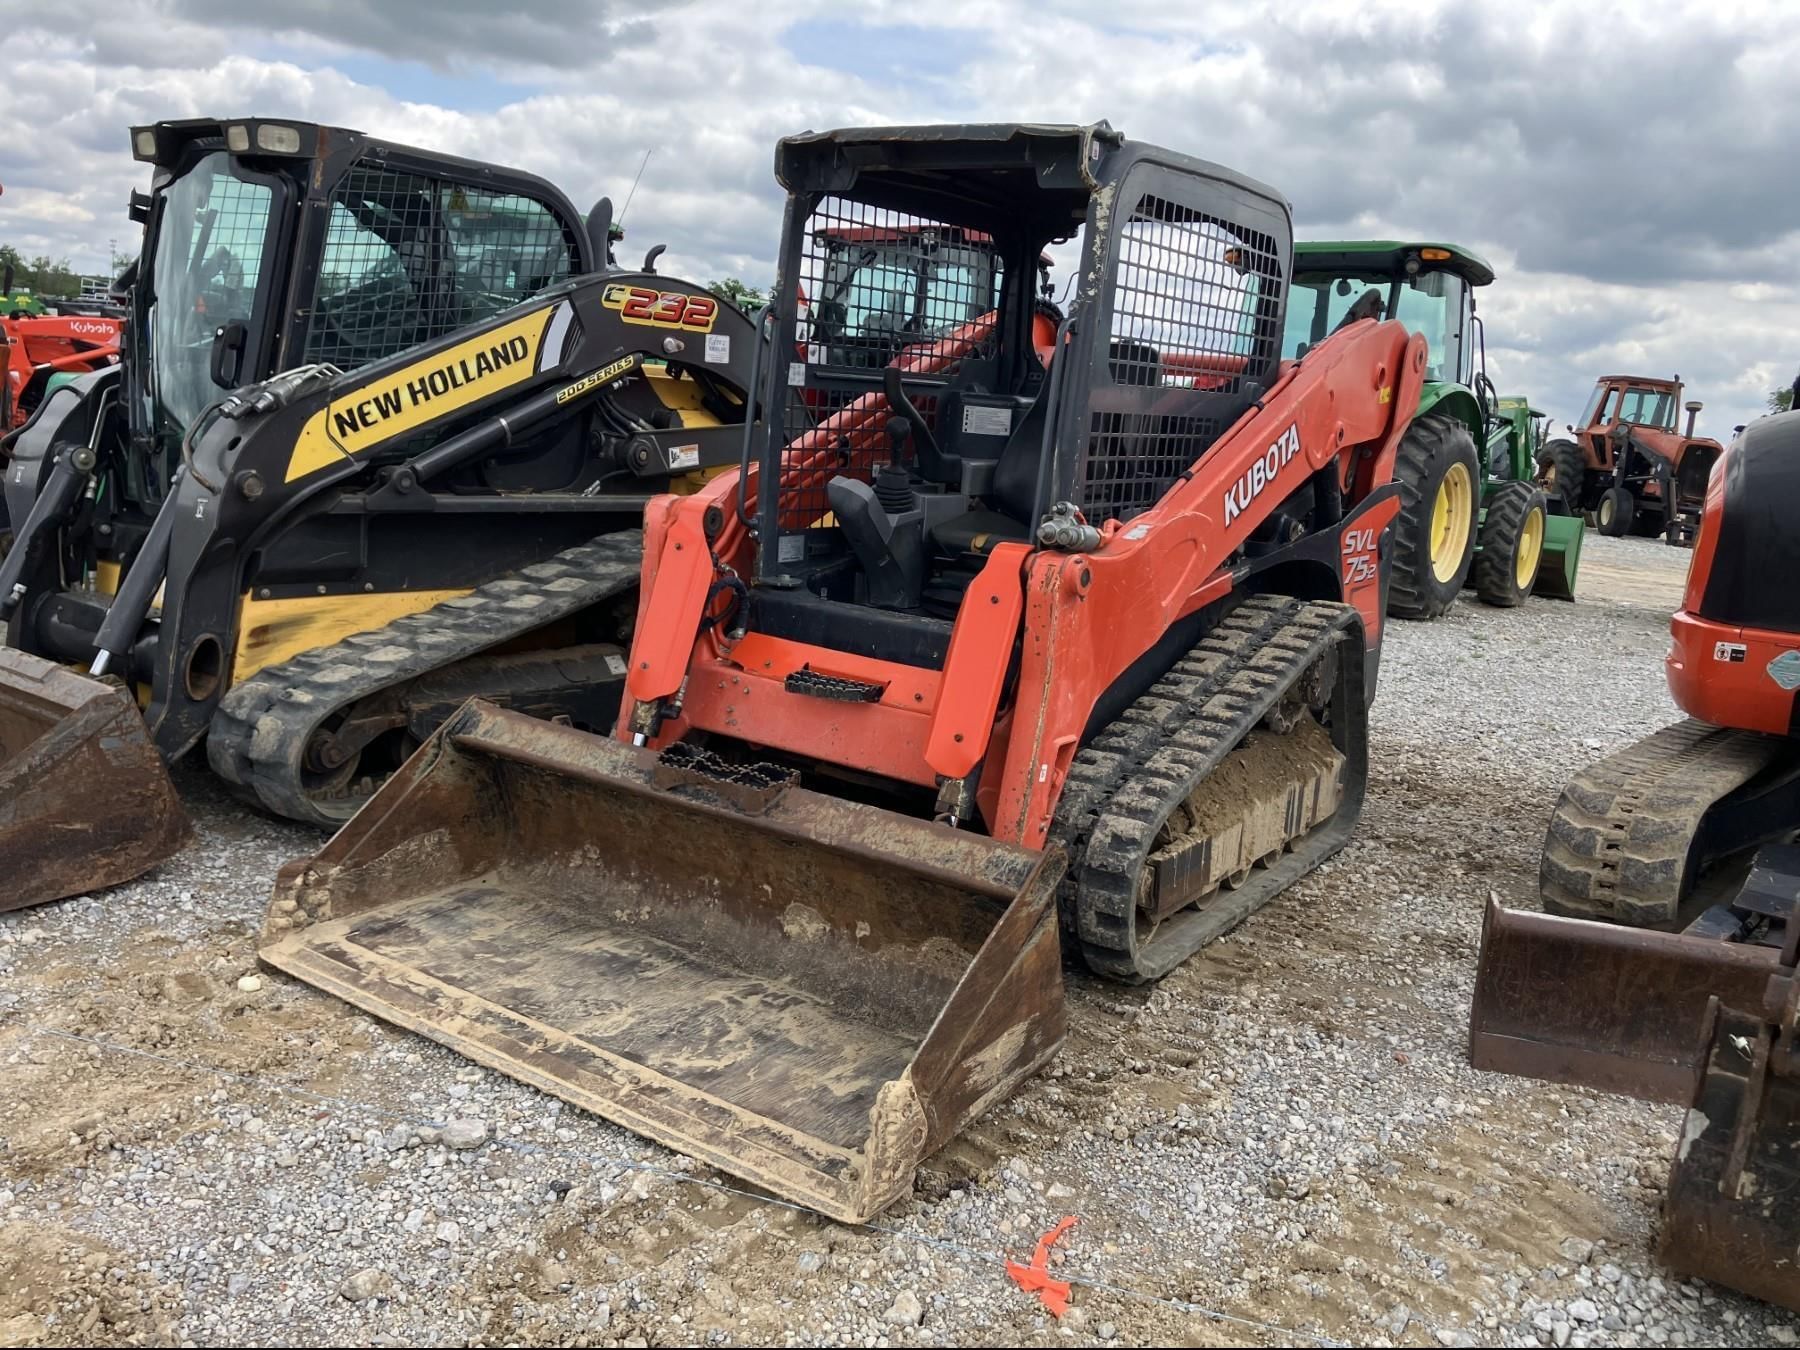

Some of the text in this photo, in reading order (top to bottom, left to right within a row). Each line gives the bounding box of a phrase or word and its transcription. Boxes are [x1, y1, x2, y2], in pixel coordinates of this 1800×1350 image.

[70, 321, 114, 334] Kubota
[604, 286, 715, 327] C232
[333, 335, 528, 439] NEW HOLLAND
[559, 356, 632, 401] 200 SERIES
[1224, 422, 1300, 528] KUBOTA
[1342, 528, 1377, 554] SVL
